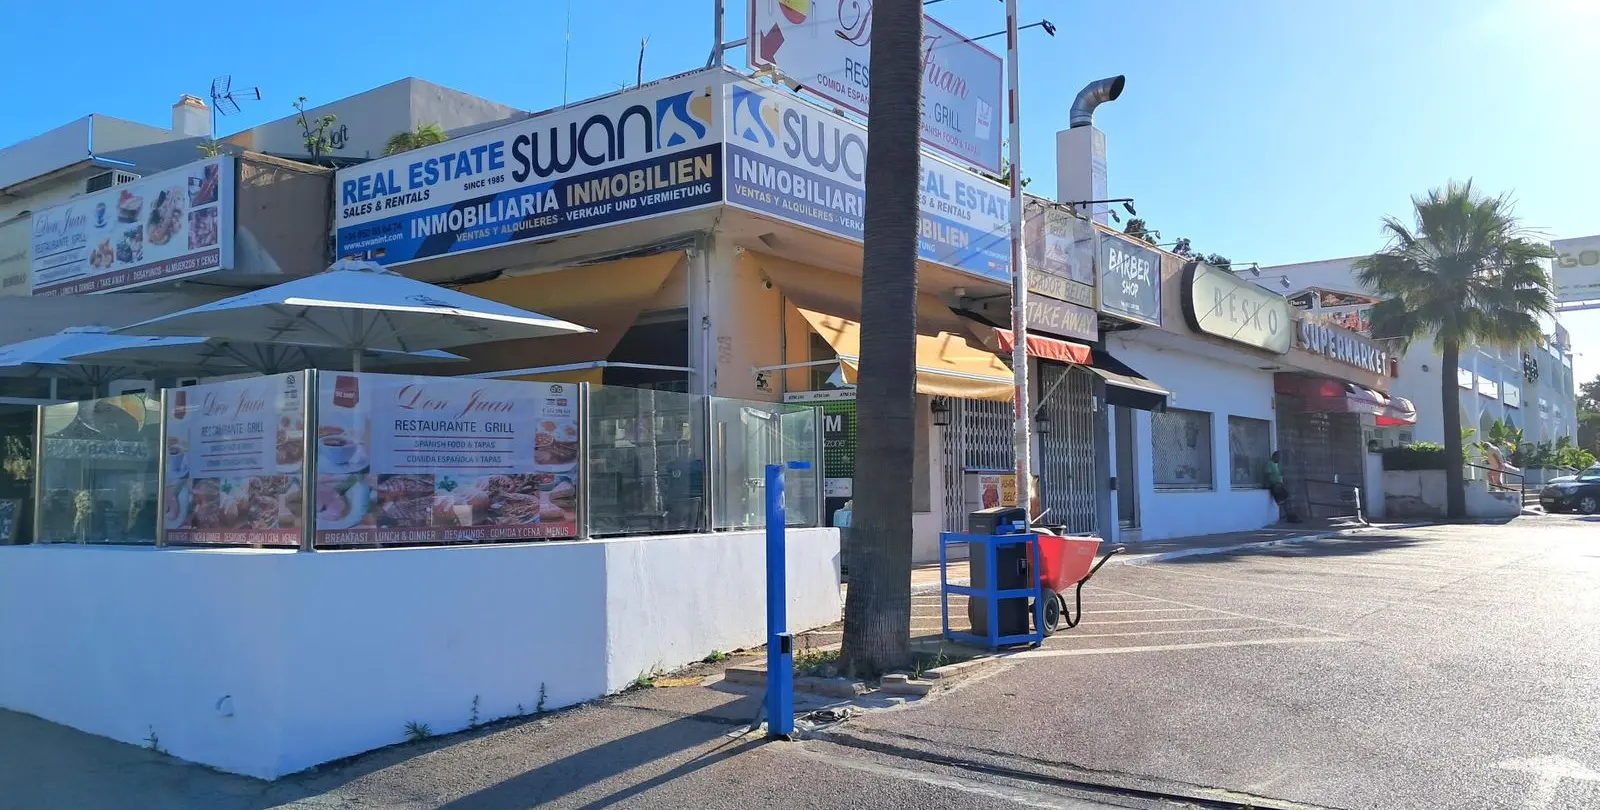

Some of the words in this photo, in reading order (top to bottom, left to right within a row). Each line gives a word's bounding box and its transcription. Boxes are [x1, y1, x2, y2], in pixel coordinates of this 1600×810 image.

[817, 73, 846, 95] COMIDA
[848, 87, 868, 103] ESPA
[921, 122, 941, 139] PANISH
[934, 102, 962, 132] GRILL
[783, 107, 867, 181] swa
[343, 168, 401, 206] REAL
[409, 140, 504, 190] ESTATE
[463, 180, 485, 191] SINCE
[488, 174, 505, 185] 1985
[733, 154, 865, 218] INMOBILIARI
[343, 203, 372, 219] SALES
[375, 201, 381, 211] &
[385, 189, 430, 209] RENTALS
[411, 189, 559, 239] INMOBILIARIA
[567, 153, 713, 207] INMOBILIEN
[735, 184, 772, 204] VENTAS
[773, 193, 780, 205] Y
[782, 199, 833, 222] ALQUILERES
[840, 216, 864, 231] VERKA
[919, 167, 950, 200] EAL
[955, 180, 1007, 221] ESTAT
[938, 200, 971, 220] RENTALS
[456, 226, 489, 242] VENTAS
[493, 224, 498, 235] Y
[501, 215, 558, 234] ALQUILERES
[566, 204, 612, 222] VERKAUF
[615, 198, 637, 212] UND
[640, 183, 712, 206] VERMIETUNG
[920, 218, 969, 250] BILIEN
[1109, 247, 1151, 287] BARBER
[1121, 280, 1139, 298] SHOP
[1027, 302, 1060, 328] TAKE
[1061, 308, 1094, 334] AWAY
[1302, 319, 1386, 375] SUPERMARKET
[394, 384, 448, 410] Don
[453, 388, 514, 420] Juan
[395, 419, 477, 432] RESTAURANTE
[485, 422, 515, 433] GRILL
[407, 455, 436, 463] COMIDA
[481, 455, 501, 463] TAPAS
[415, 440, 446, 448] SPANISH
[474, 441, 495, 449] TAPAS
[325, 532, 368, 543] BREAKFAST
[375, 531, 399, 542] LUNCH
[402, 531, 406, 541] &
[409, 530, 436, 541] DINNER
[444, 529, 485, 539] DESAYUNOS
[490, 528, 517, 538] COMIDA
[523, 527, 540, 537] CENA
[546, 526, 569, 536] MENUS
